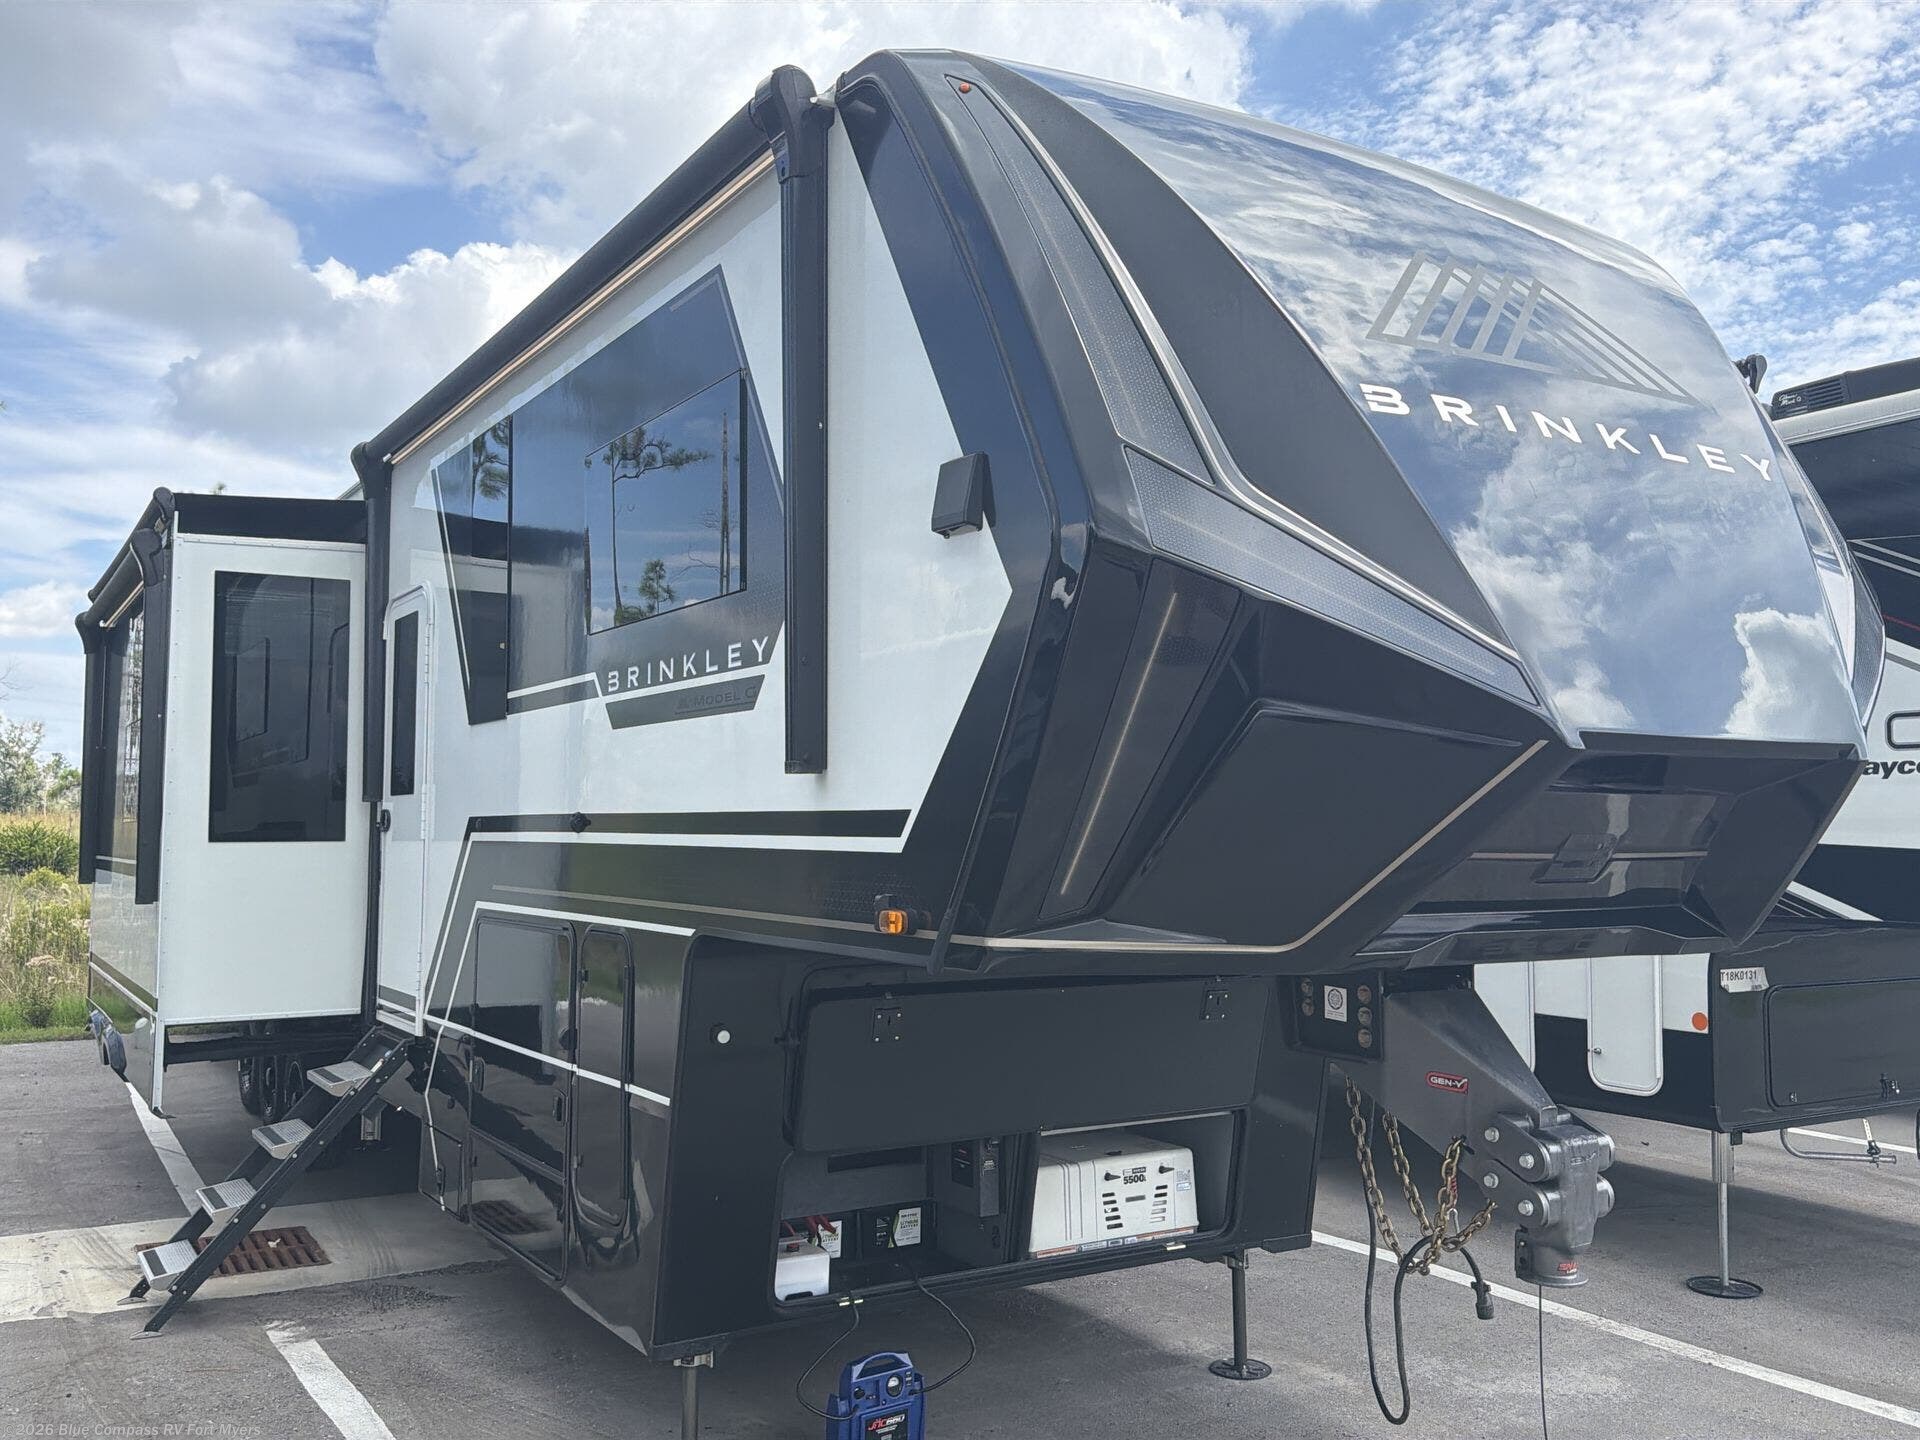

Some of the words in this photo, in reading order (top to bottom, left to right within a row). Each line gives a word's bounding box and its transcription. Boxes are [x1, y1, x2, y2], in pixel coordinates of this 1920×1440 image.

[1359, 383, 1772, 481] BRINKLEY
[608, 636, 769, 693] BRINKLEY
[694, 690, 741, 707] MODEL
[1862, 759, 1920, 780] ayc
[1430, 1076, 1468, 1088] GEN-Y
